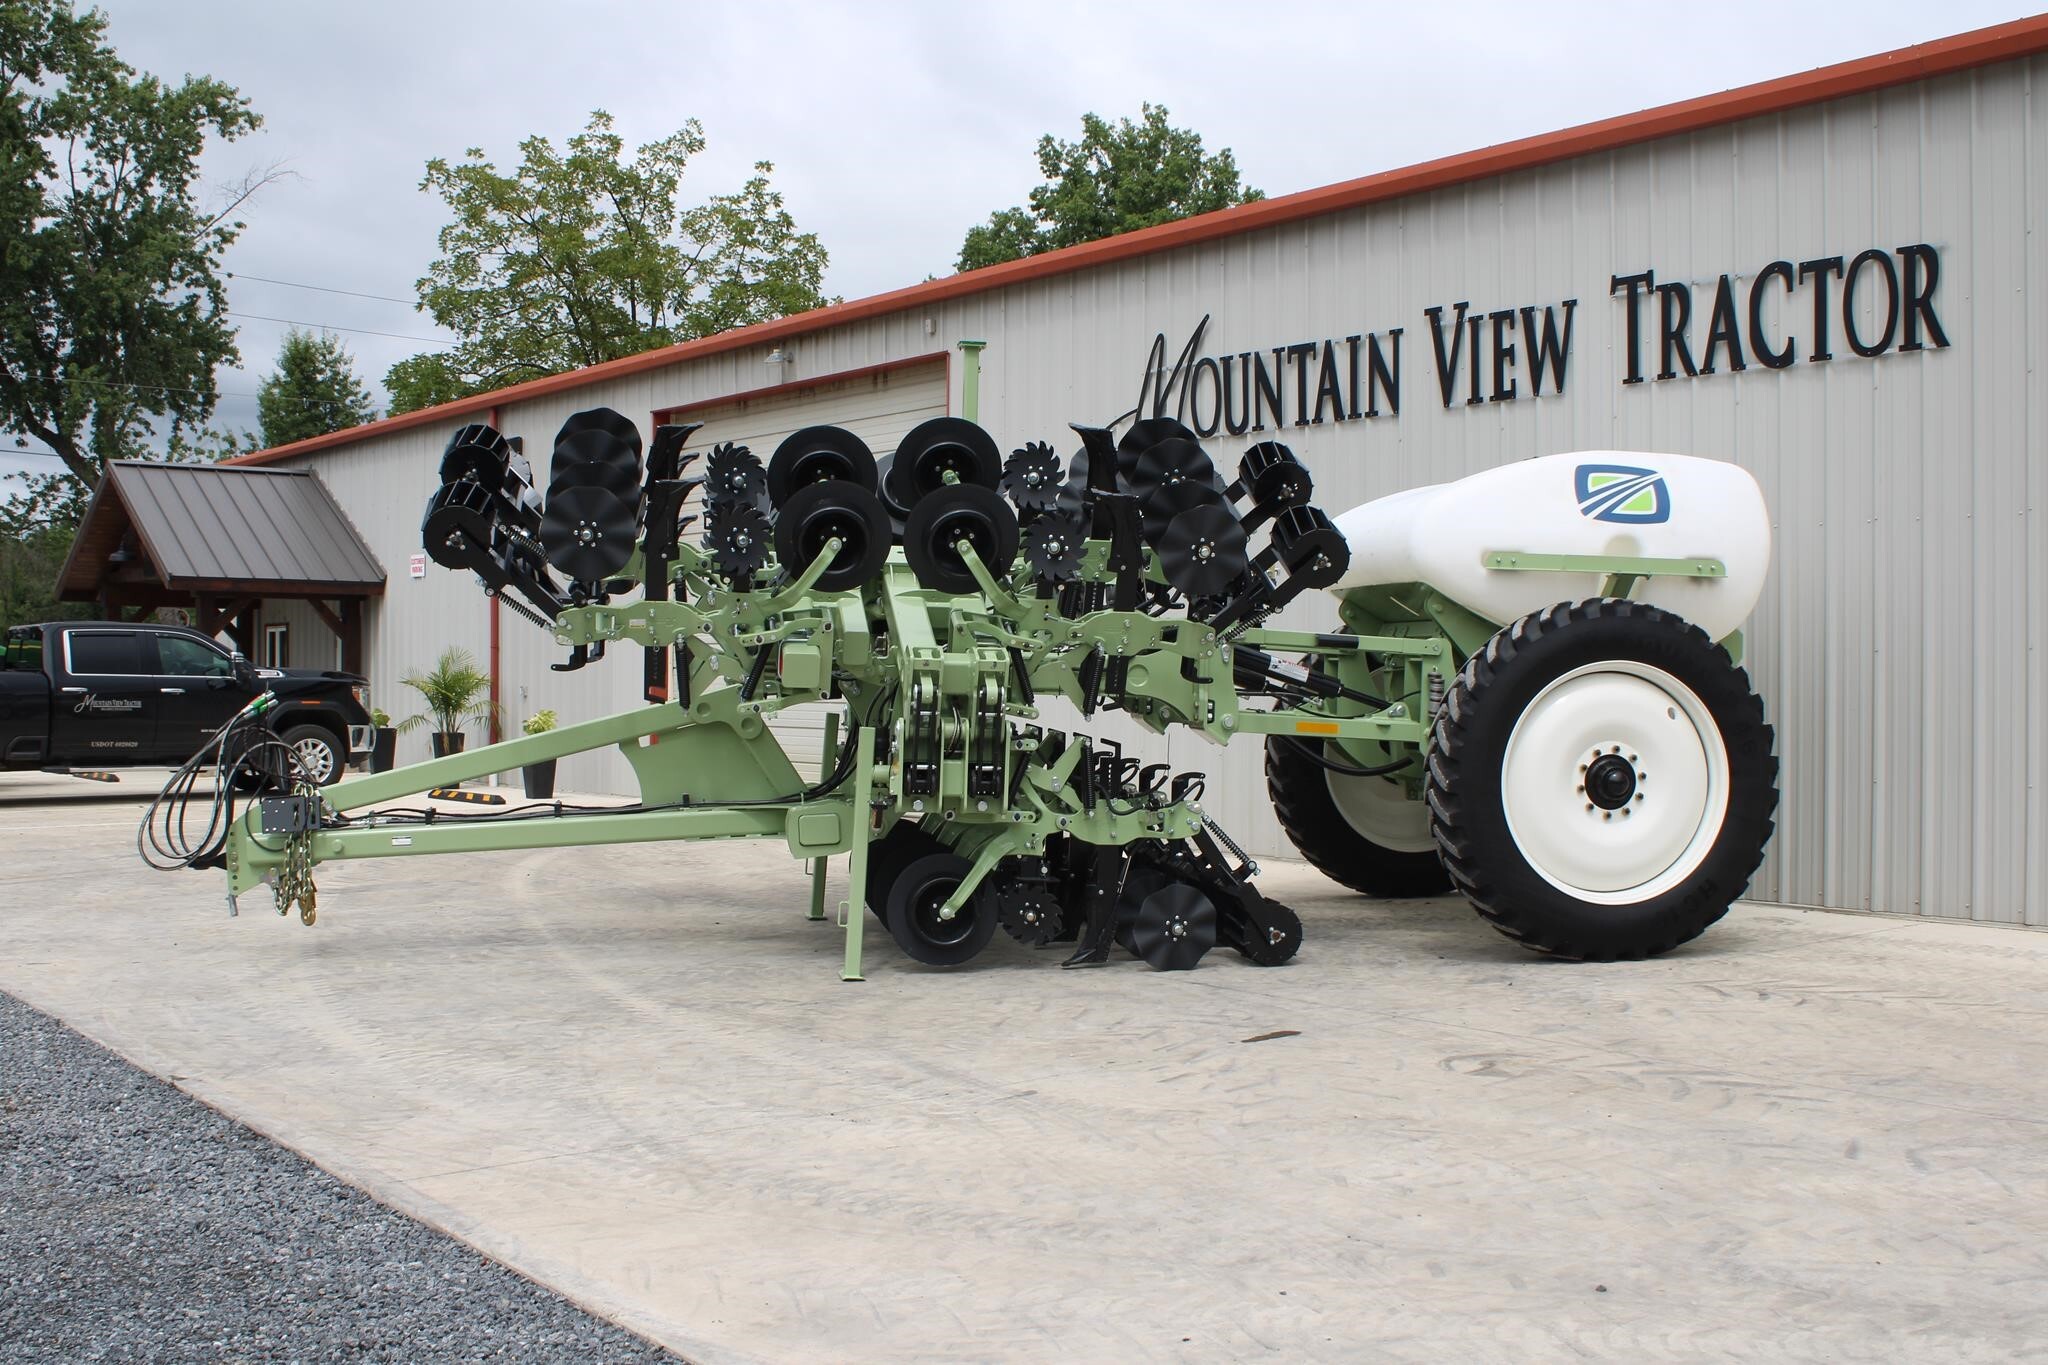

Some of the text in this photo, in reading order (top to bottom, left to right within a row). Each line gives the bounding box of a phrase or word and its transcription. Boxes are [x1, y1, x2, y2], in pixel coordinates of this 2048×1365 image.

[1106, 243, 1951, 438] MOUNTAIN VIEW TRACTOR
